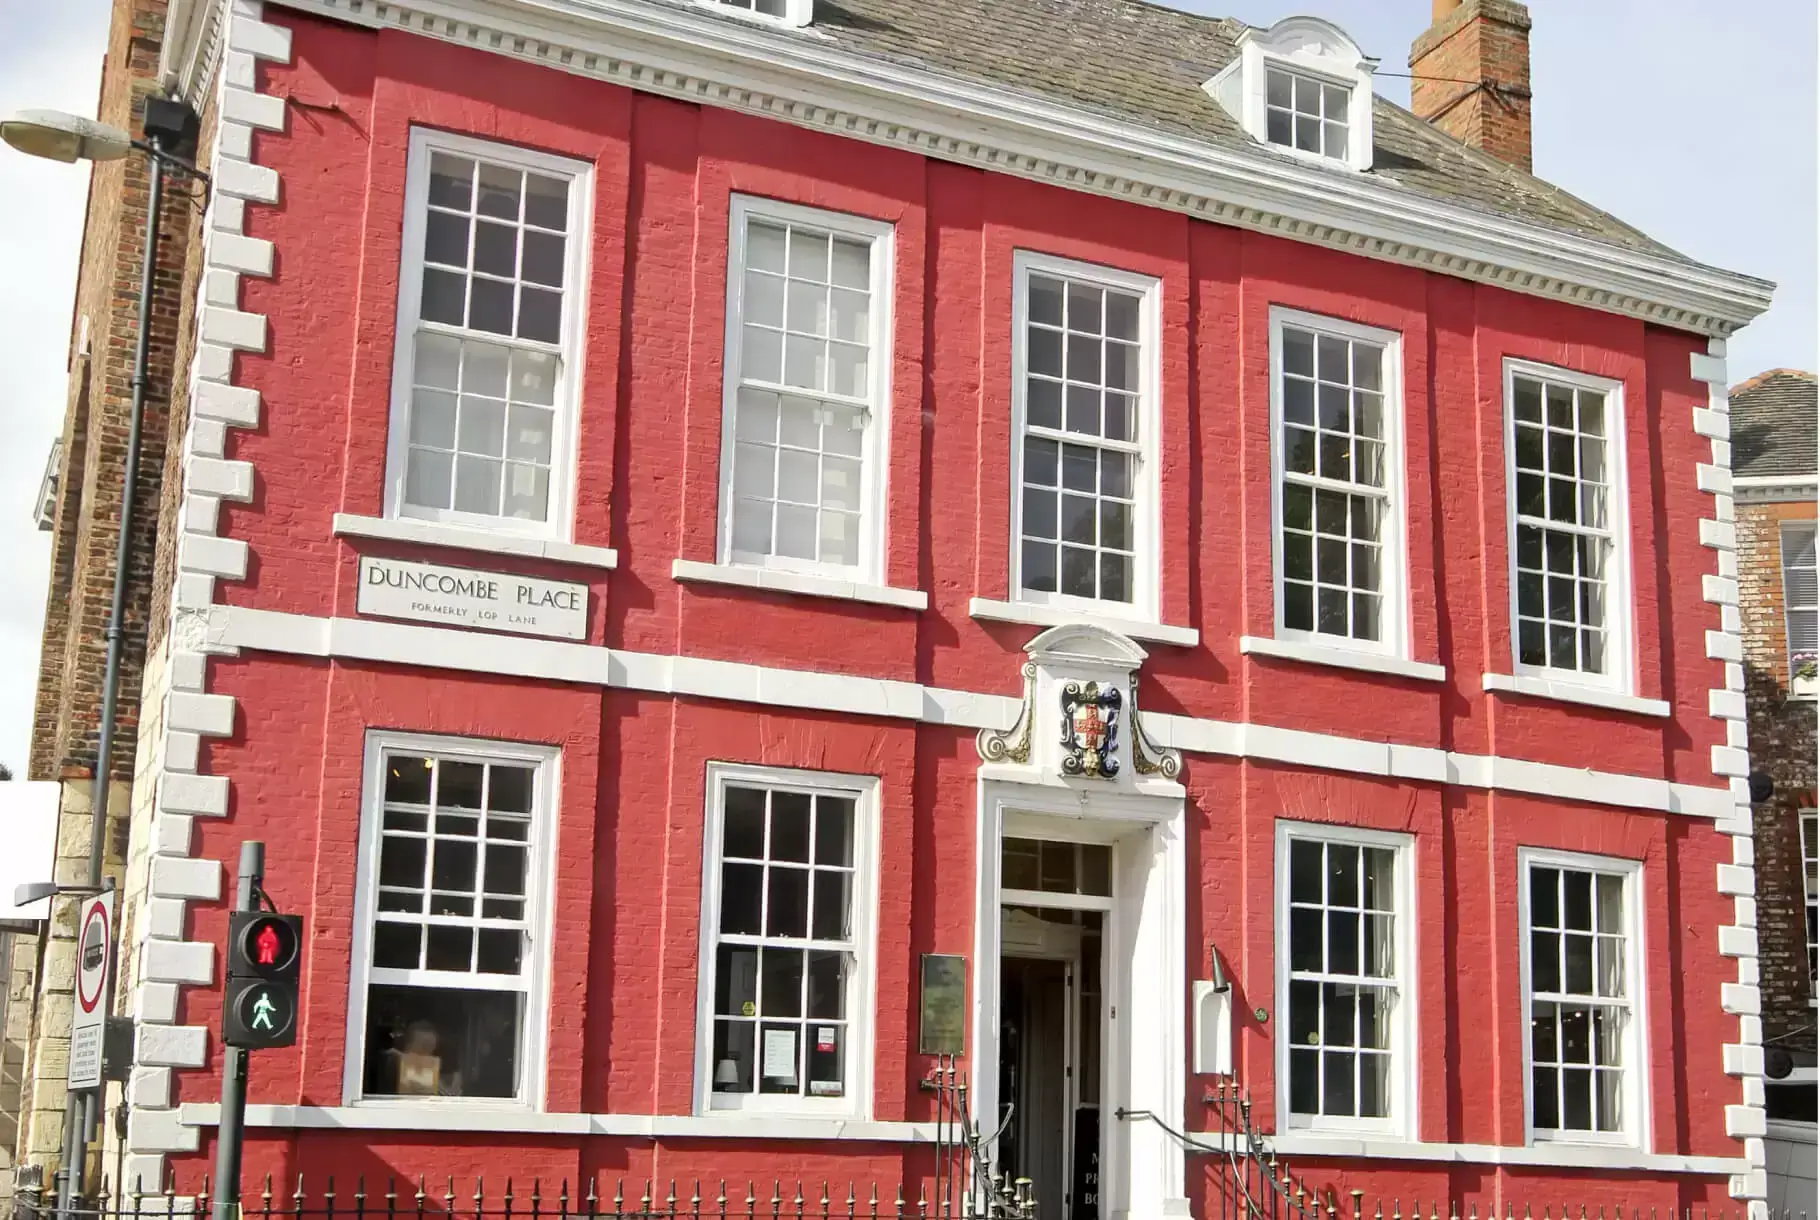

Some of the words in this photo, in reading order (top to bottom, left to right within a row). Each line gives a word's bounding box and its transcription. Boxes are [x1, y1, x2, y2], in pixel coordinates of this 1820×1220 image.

[368, 566, 498, 600] DUNCOMBE
[517, 585, 581, 611] PLACE
[411, 602, 468, 617] FORMERLY
[478, 611, 498, 621] LOP
[508, 614, 537, 625] LANE
